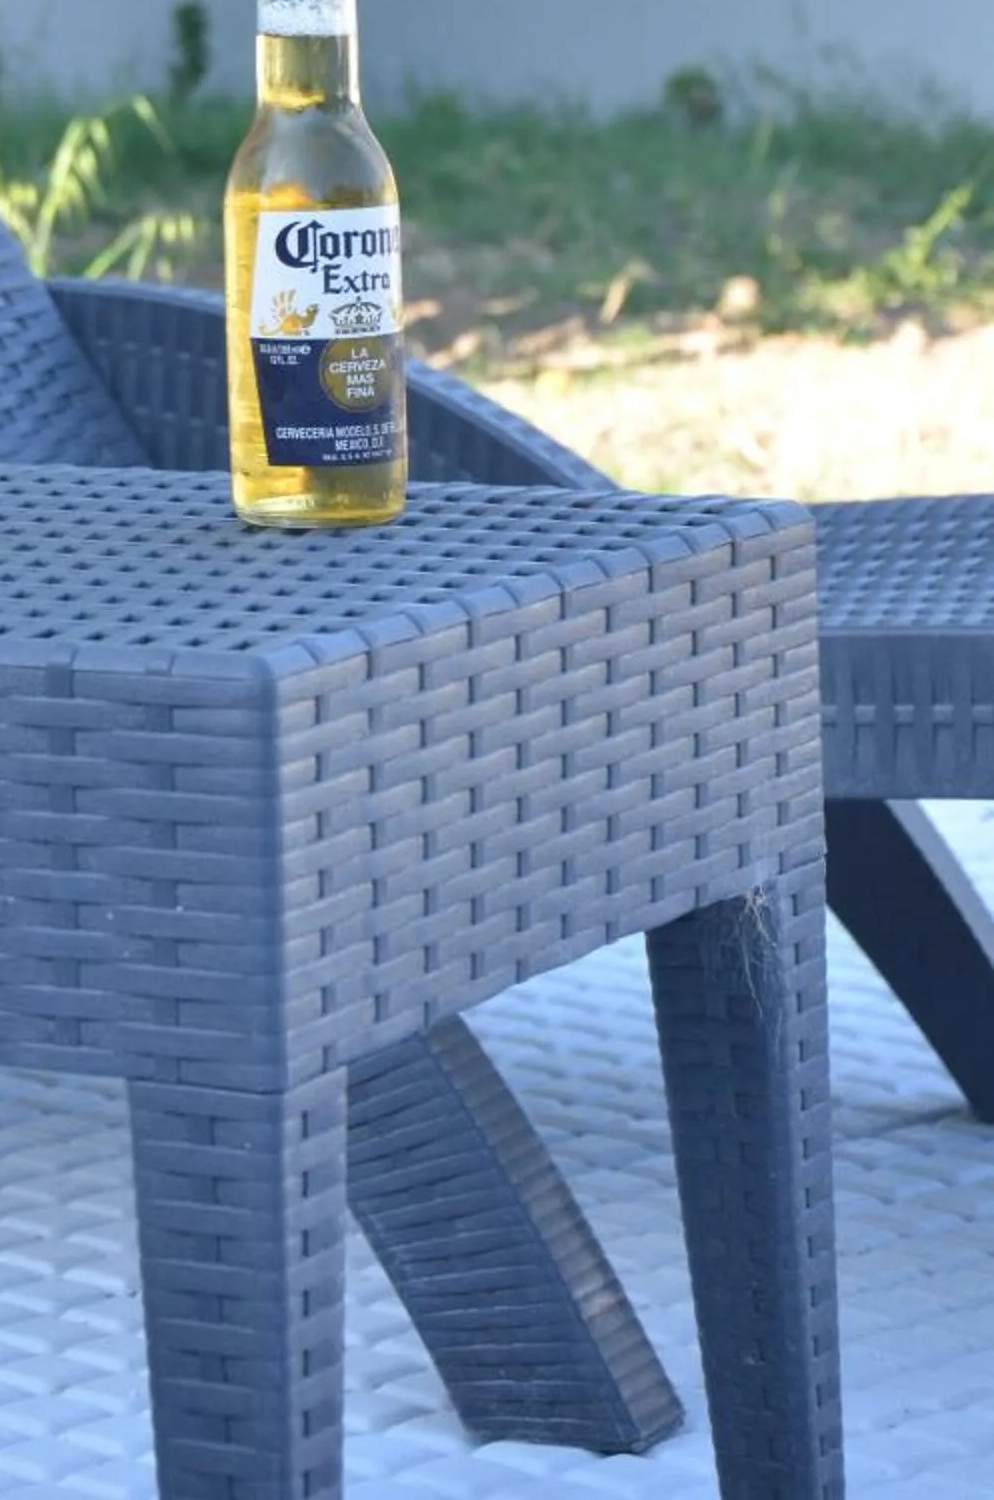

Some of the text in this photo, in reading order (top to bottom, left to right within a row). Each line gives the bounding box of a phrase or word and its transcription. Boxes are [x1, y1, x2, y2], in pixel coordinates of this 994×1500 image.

[322, 264, 390, 294] Extra
[351, 348, 368, 359] LA
[329, 359, 386, 373] CERVEZA
[347, 373, 375, 386] MAS
[347, 386, 375, 399] FINA
[275, 427, 335, 440] CERVECERIA
